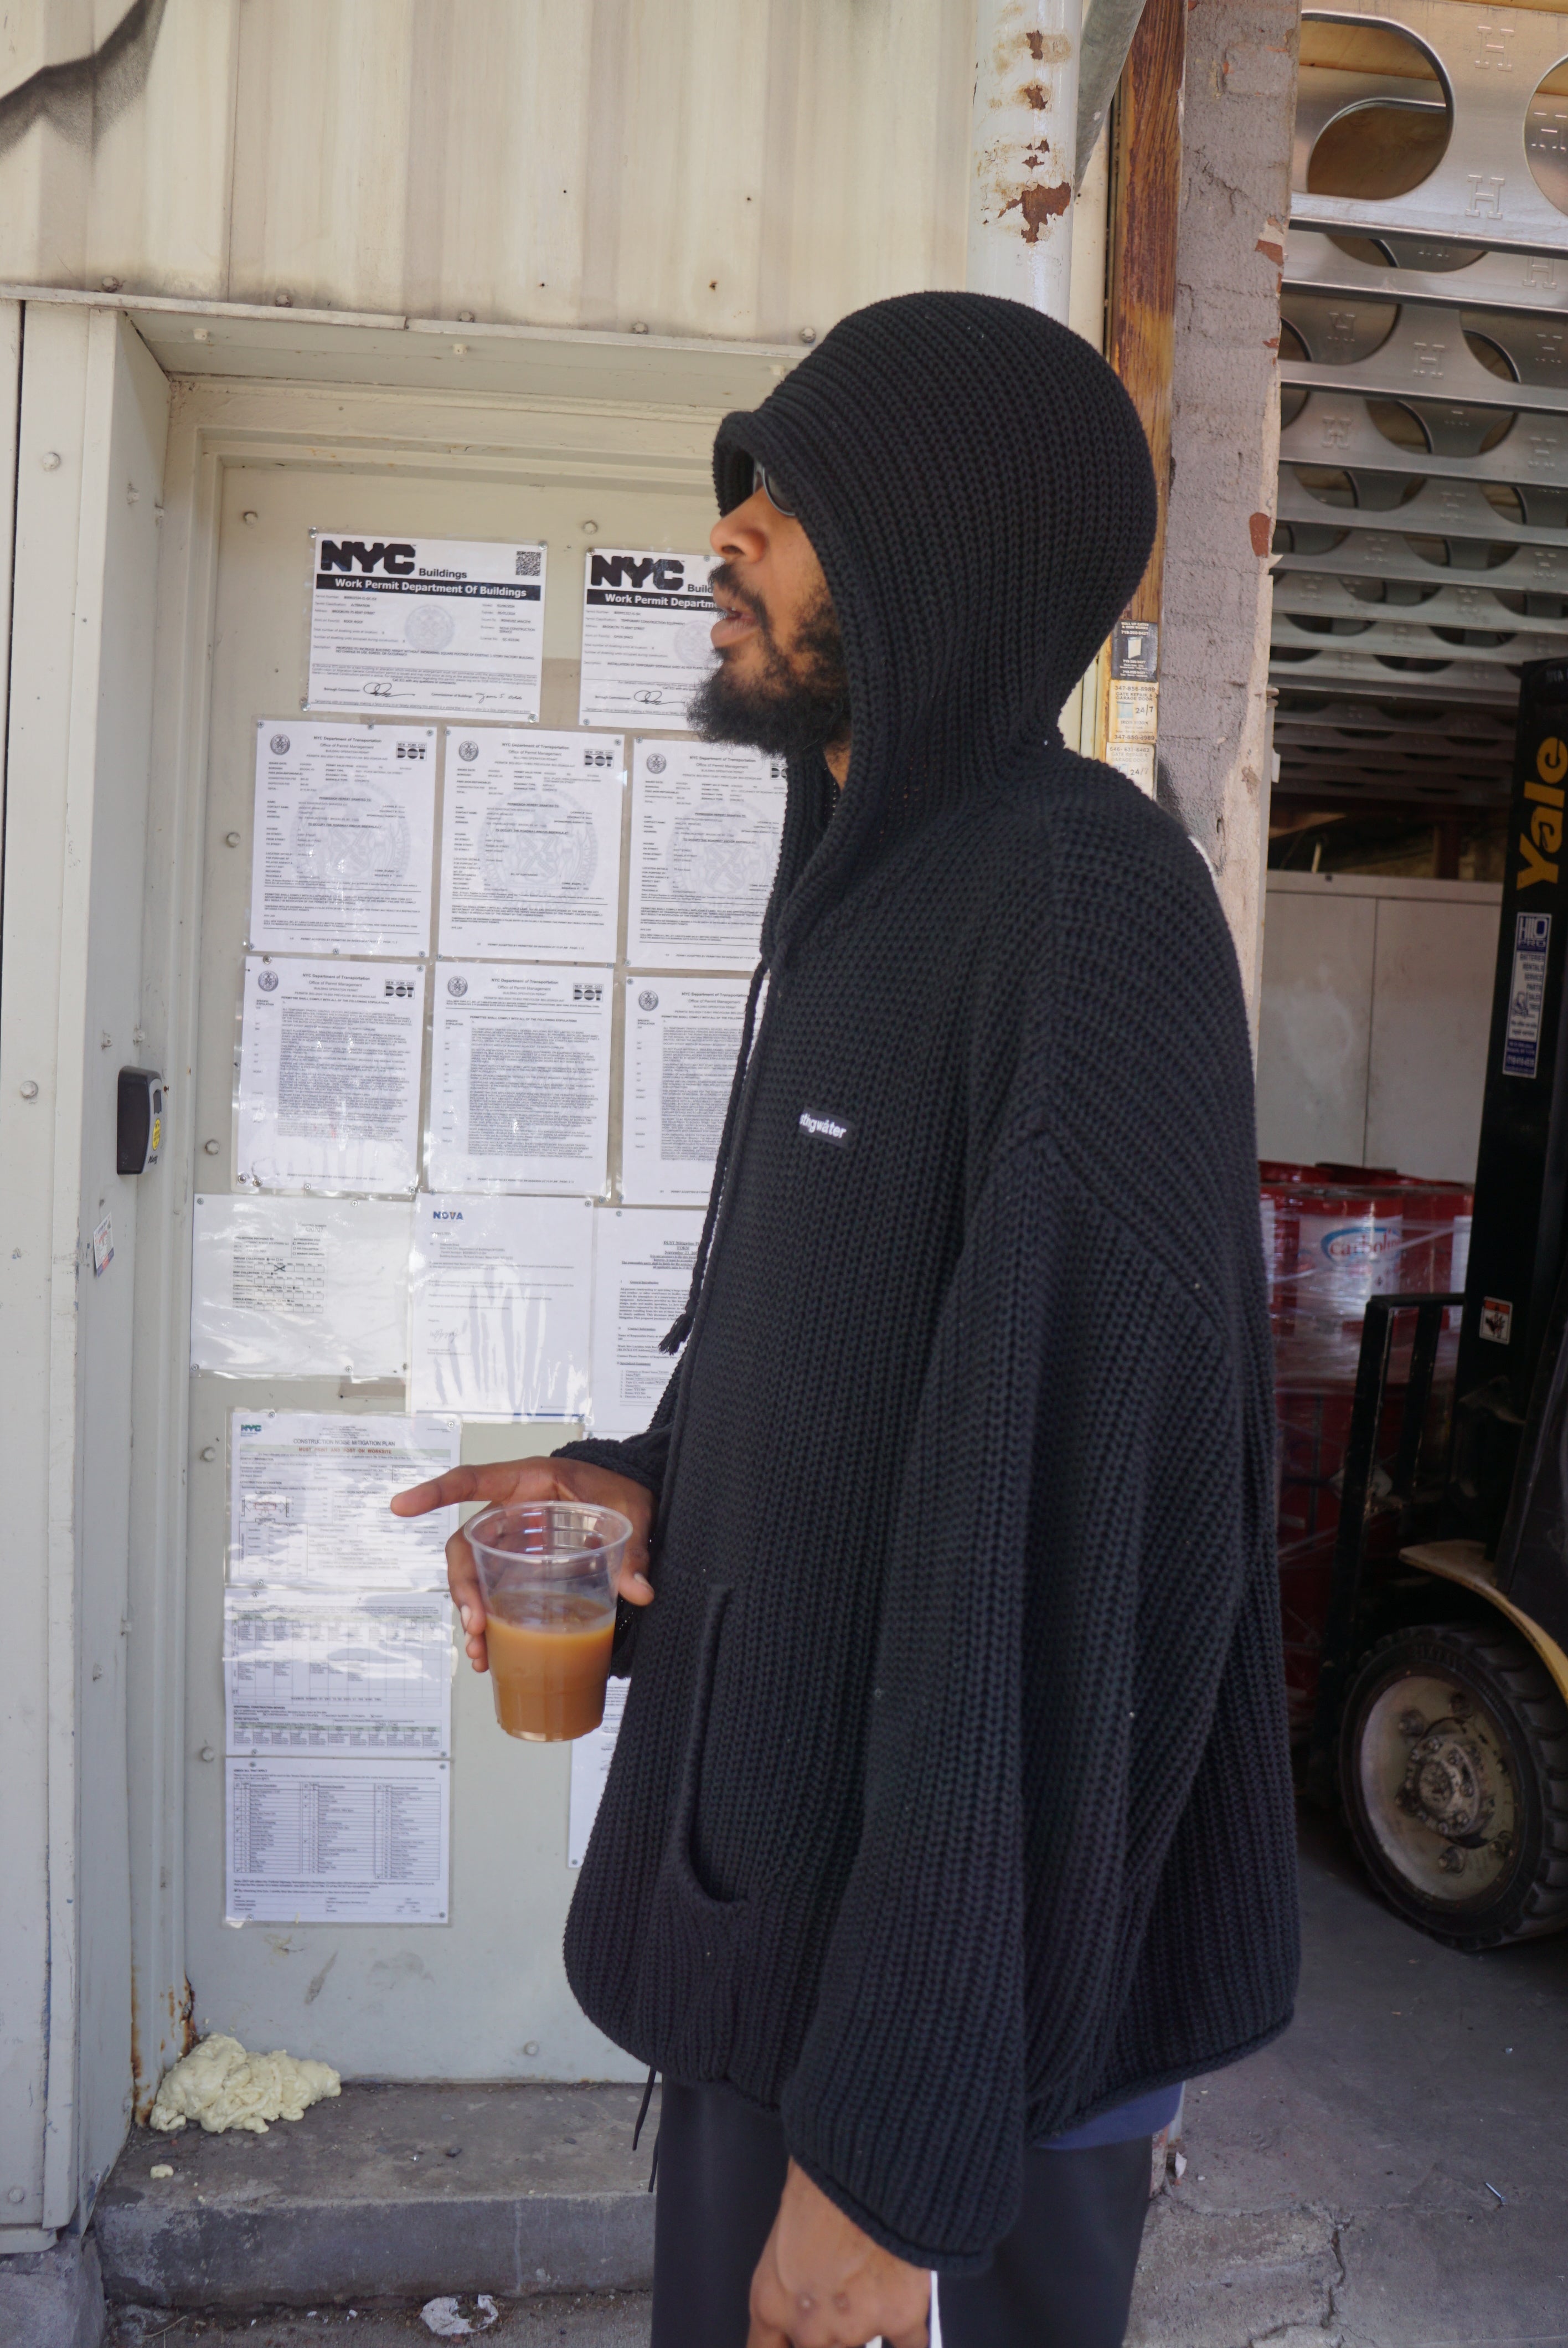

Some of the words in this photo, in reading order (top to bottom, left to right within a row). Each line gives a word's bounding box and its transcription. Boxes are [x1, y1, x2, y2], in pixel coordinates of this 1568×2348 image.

[321, 540, 415, 575] NYC
[419, 568, 467, 579] Buildings
[591, 555, 684, 591] NYC
[335, 578, 362, 589] Work
[365, 580, 399, 590] Permit
[402, 582, 463, 594] Department
[466, 585, 478, 594] Of
[480, 586, 527, 598] Buildings
[688, 584, 713, 593] Build
[605, 594, 632, 603] Work
[635, 595, 668, 605] Permit
[670, 598, 718, 610] Departme
[1135, 704, 1153, 715] 24/7
[398, 748, 426, 759] DOT
[585, 755, 613, 766] DOT
[1517, 736, 1568, 891] Yale
[1518, 939, 1546, 948] PRO
[385, 986, 414, 997] DOT
[574, 989, 602, 1000] DOT
[433, 1211, 464, 1220] NOVA
